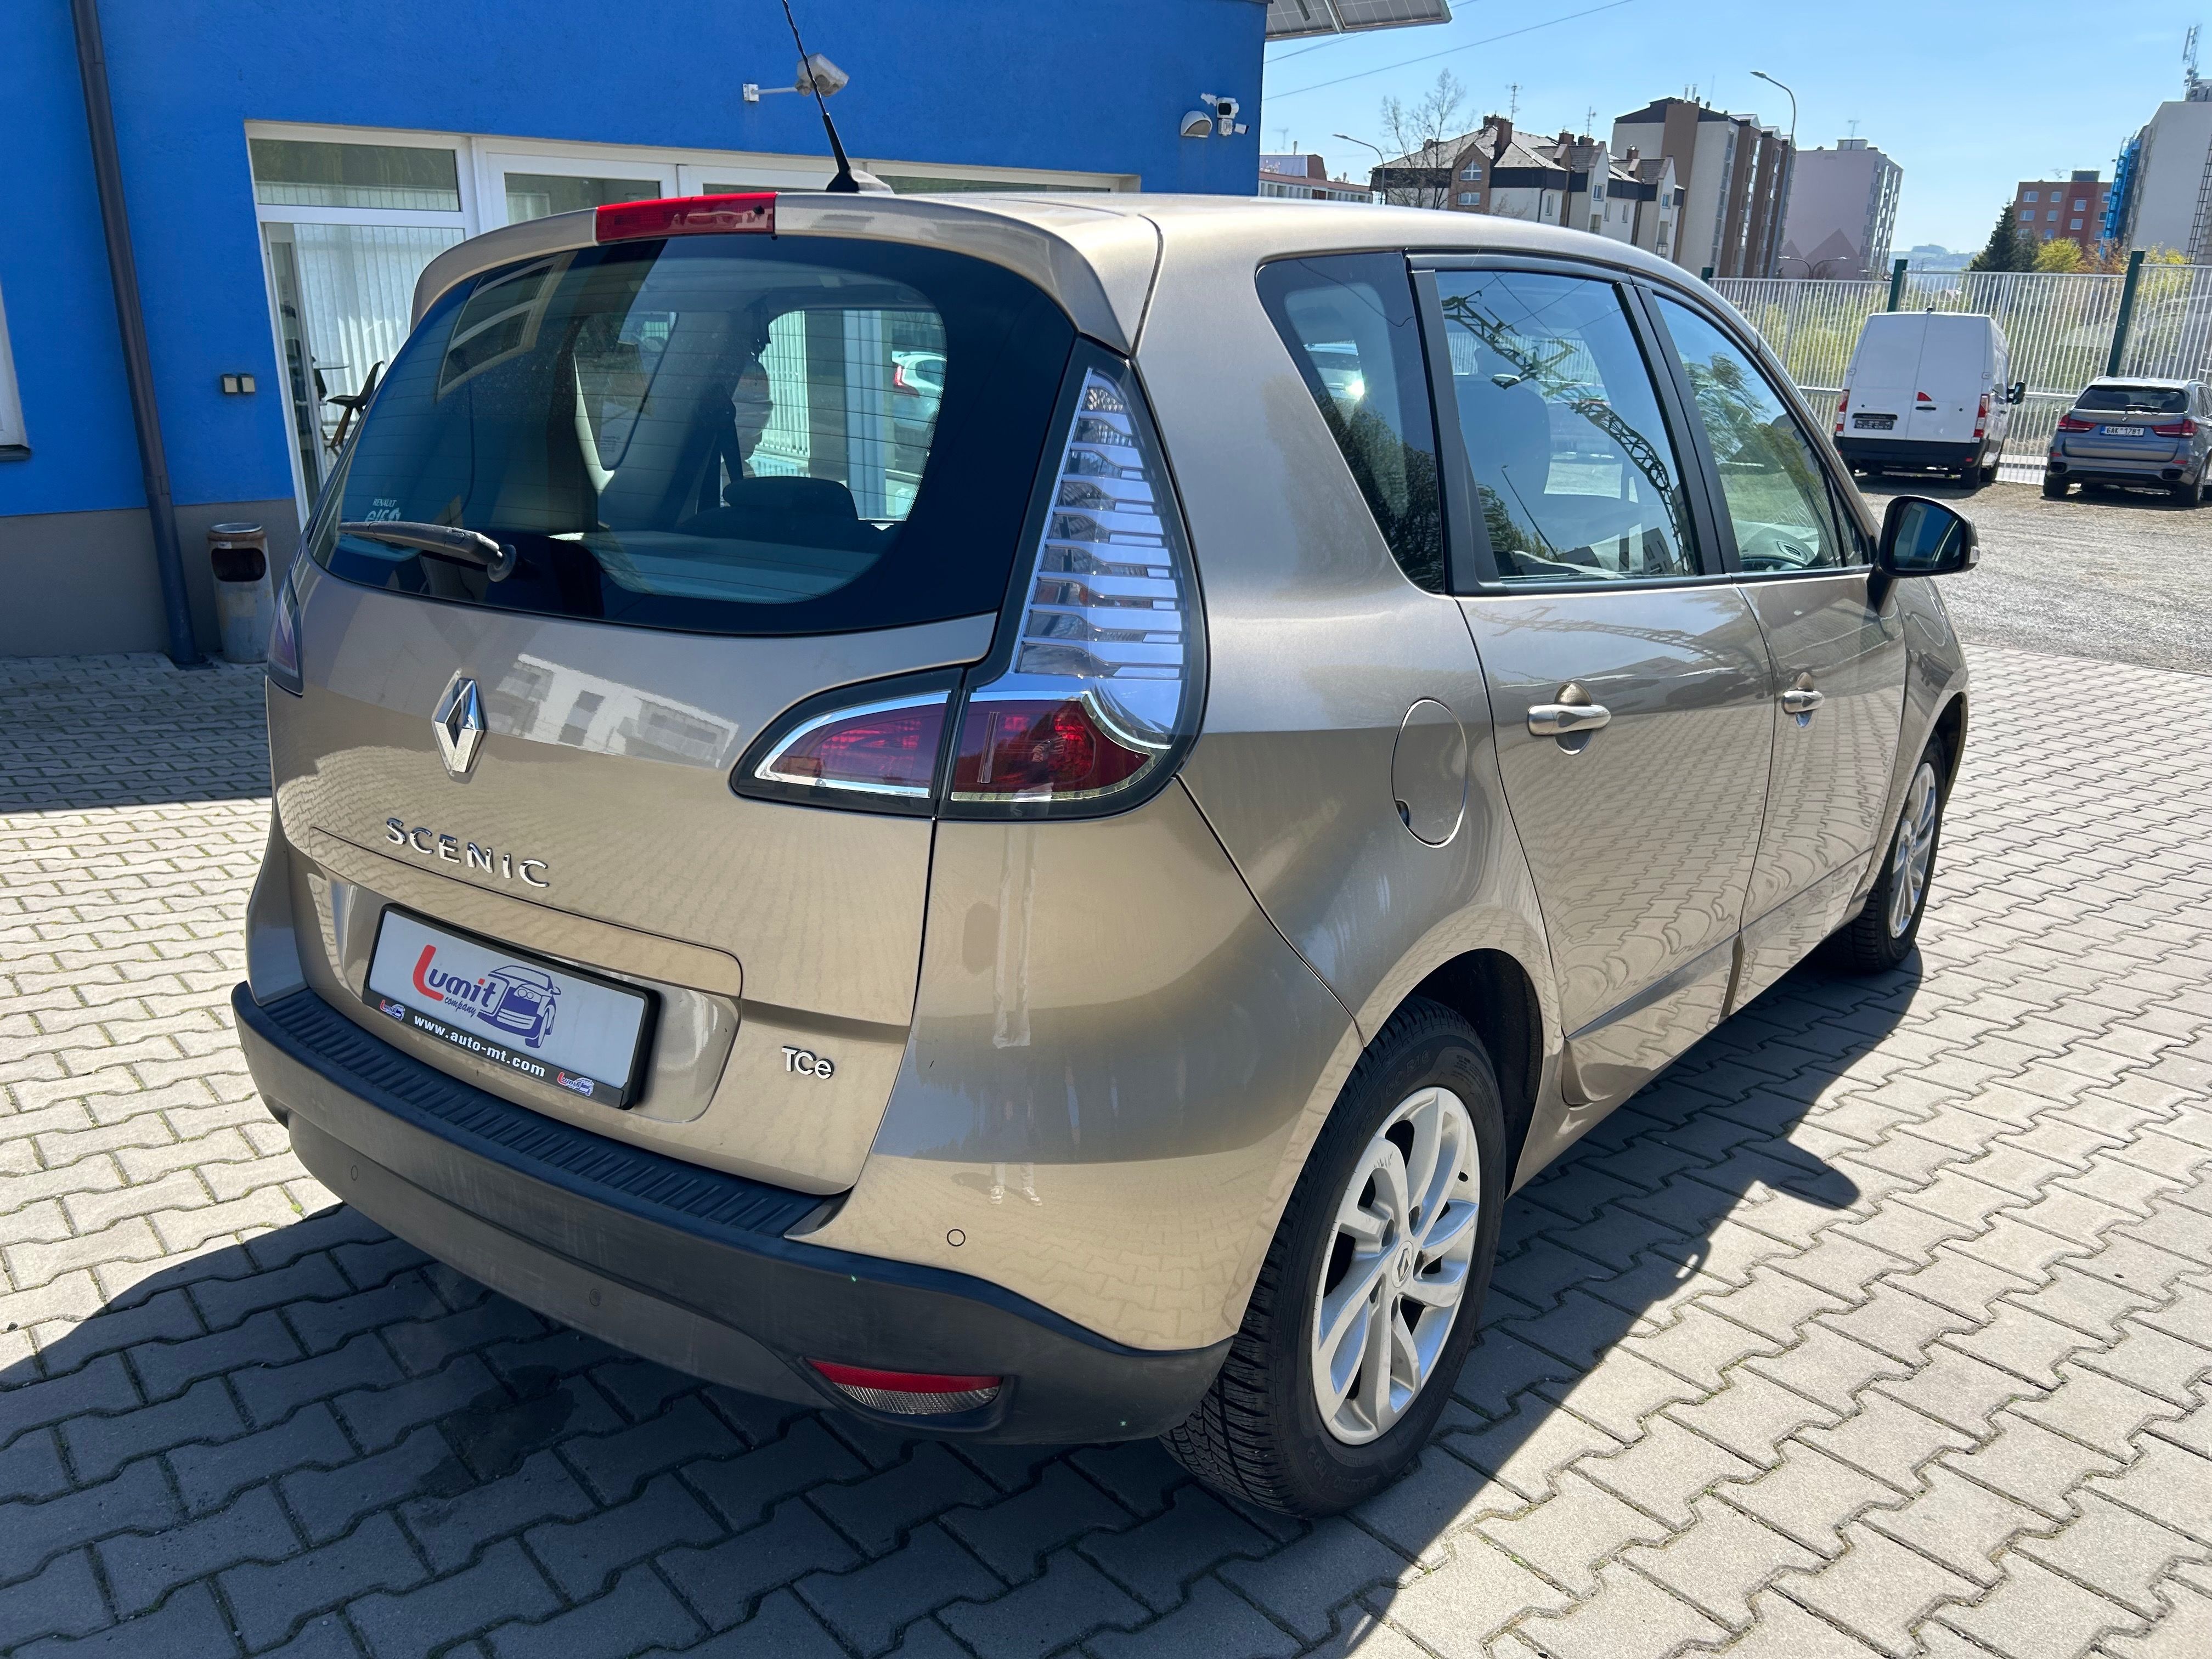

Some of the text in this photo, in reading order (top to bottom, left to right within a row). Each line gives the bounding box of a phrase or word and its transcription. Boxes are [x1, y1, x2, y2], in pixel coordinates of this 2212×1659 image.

[373, 498, 397, 507] RENAULT
[386, 817, 549, 888] SCENIC
[413, 944, 496, 1007] Lumit
[444, 996, 477, 1018] company
[415, 1015, 545, 1077] www.auto-mt.com
[781, 1045, 834, 1080] TCe
